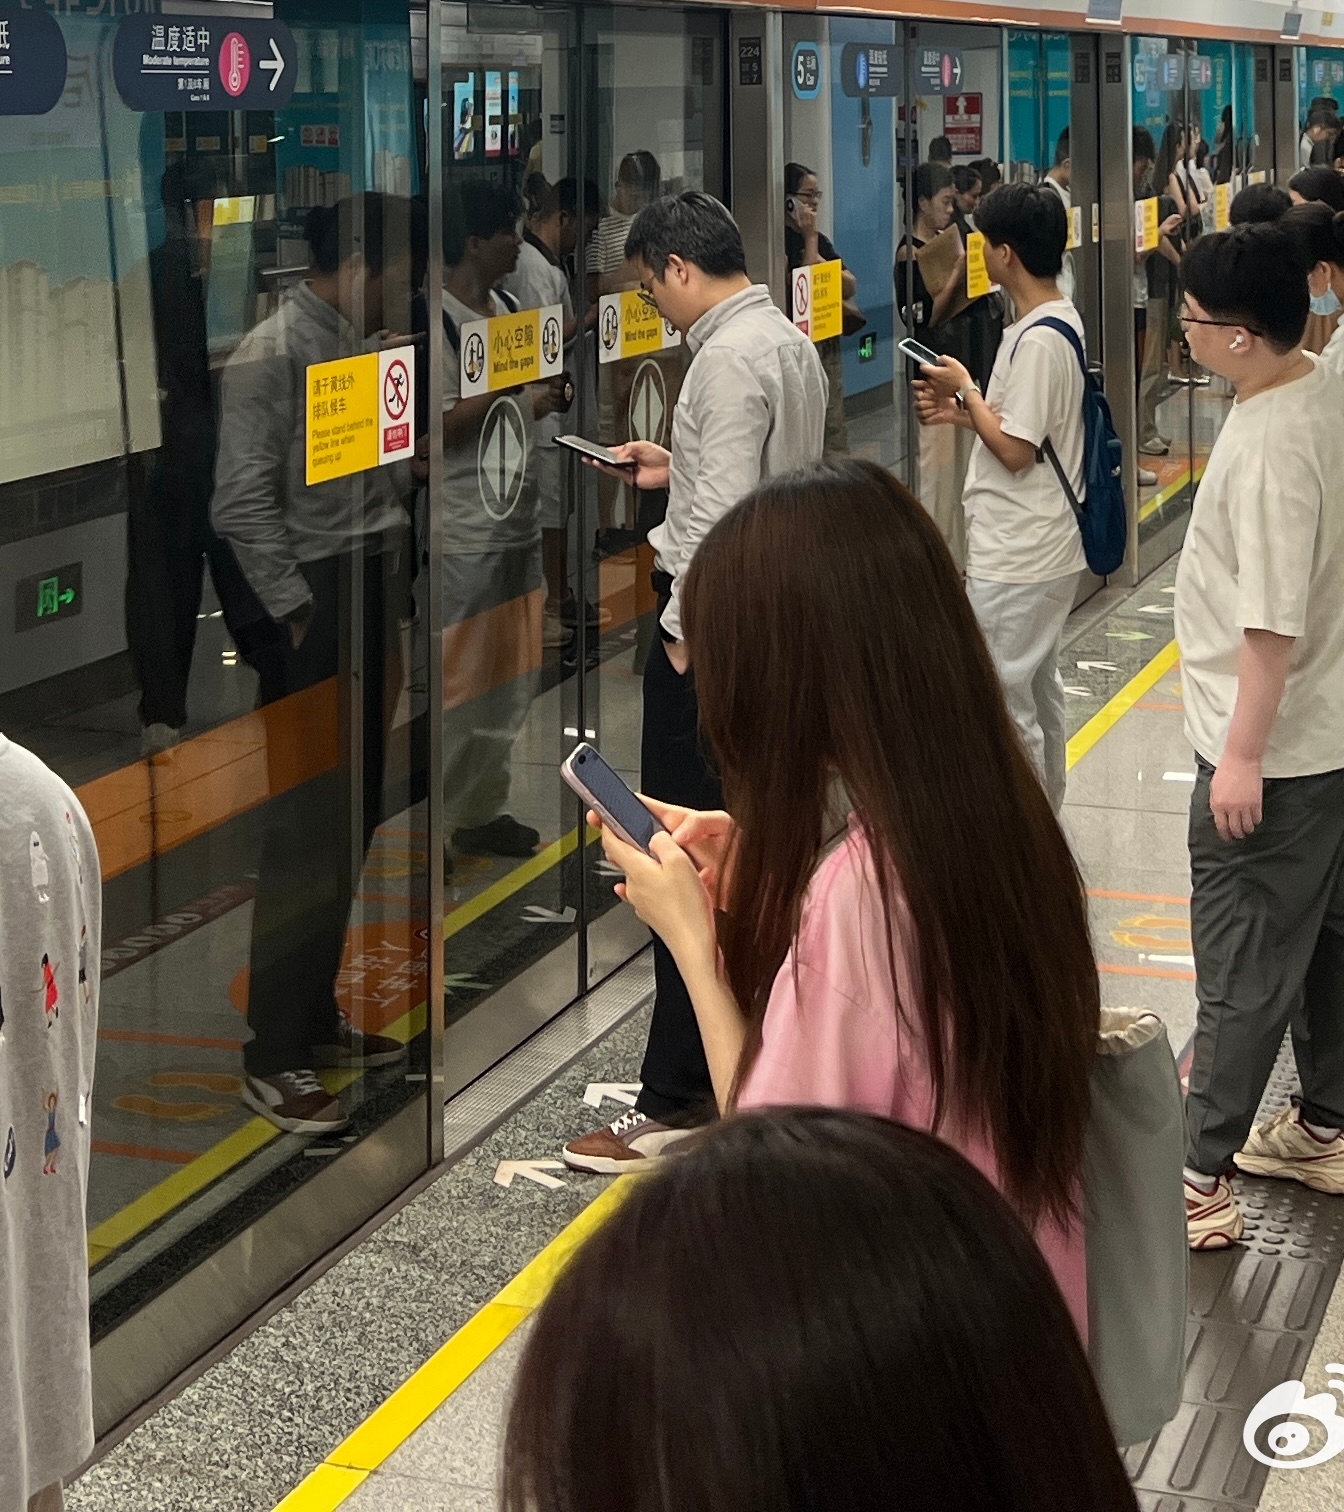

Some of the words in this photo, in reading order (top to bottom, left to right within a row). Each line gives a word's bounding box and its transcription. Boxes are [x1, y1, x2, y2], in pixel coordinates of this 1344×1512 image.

[151, 24, 210, 52] 温度适中
[740, 46, 760, 58] 224
[797, 55, 805, 85] 5
